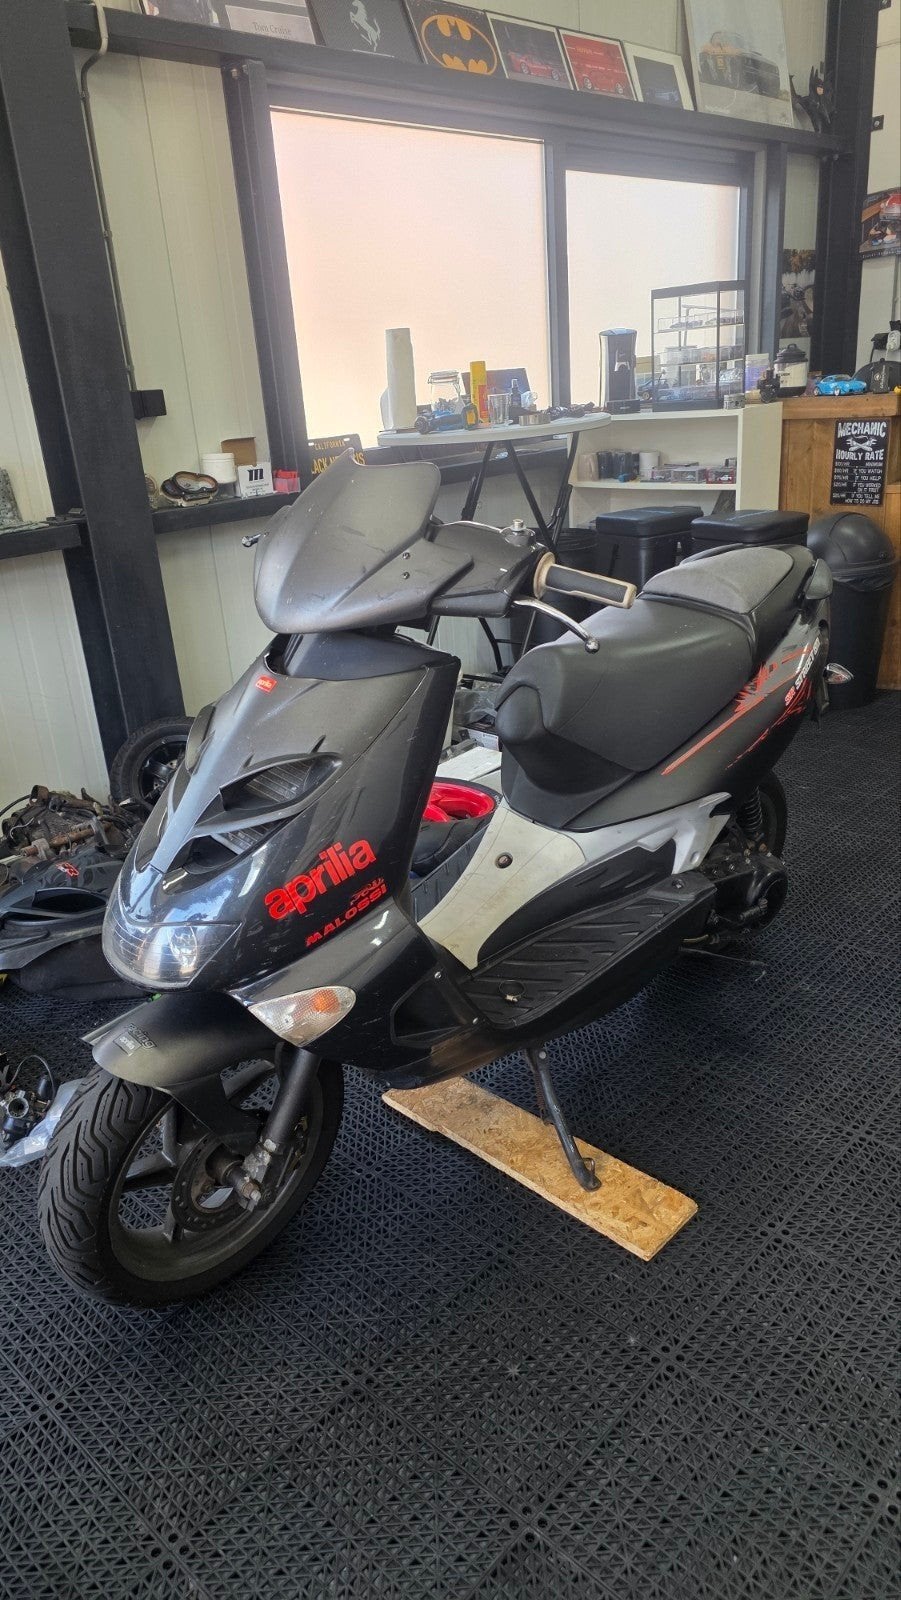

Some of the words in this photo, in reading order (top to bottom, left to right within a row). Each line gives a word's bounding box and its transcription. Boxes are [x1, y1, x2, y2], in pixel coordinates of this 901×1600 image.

[252, 21, 269, 33] Tom
[837, 421, 887, 439] MECHANIC
[314, 439, 346, 451] CALIFORNIA
[835, 448, 864, 461] HOURLY
[864, 448, 885, 461] RATE
[264, 839, 377, 920] aprilia
[305, 883, 388, 948] MALOSSI
